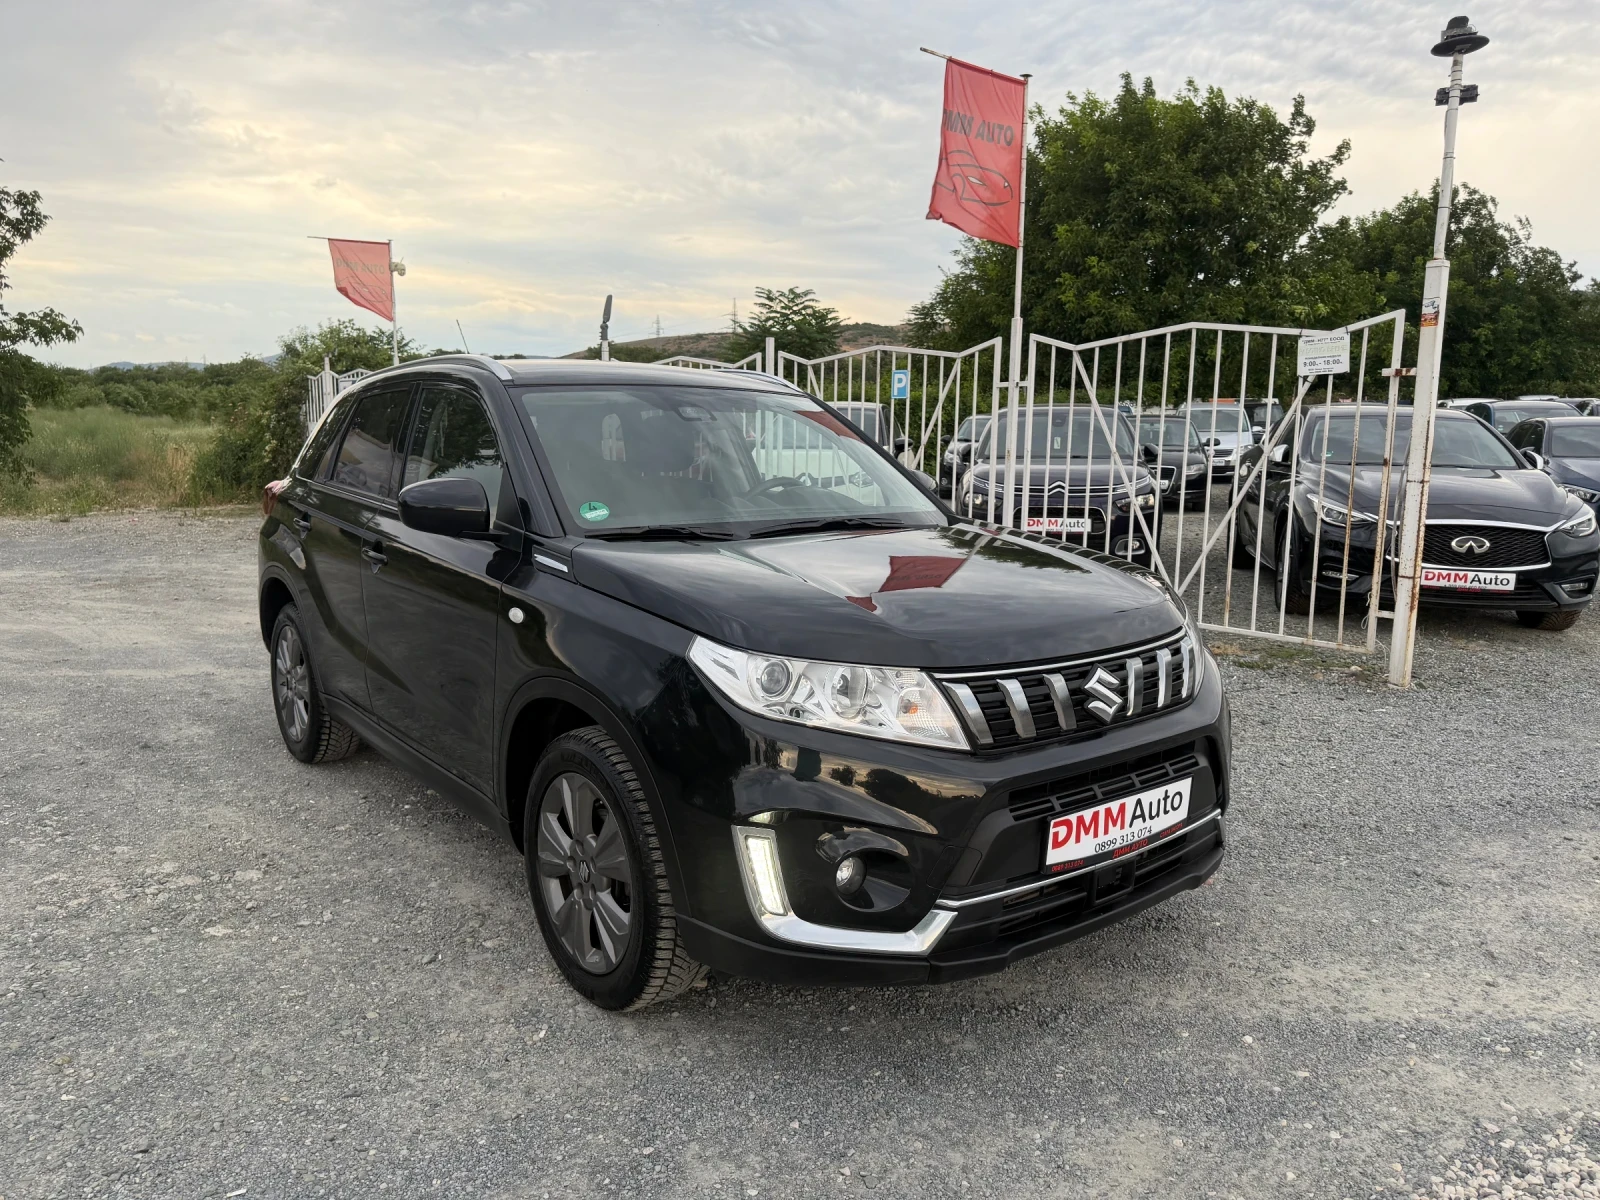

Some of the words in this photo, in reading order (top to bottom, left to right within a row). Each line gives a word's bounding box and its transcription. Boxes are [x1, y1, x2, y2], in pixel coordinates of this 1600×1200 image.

[975, 120, 1014, 147] AUTO
[893, 373, 907, 396] P
[1094, 837, 1117, 853] 0899
[1119, 831, 1135, 845] 313
[1137, 825, 1152, 840] 074
[1112, 846, 1130, 859] ДММ
[1130, 839, 1148, 852] АУТО
